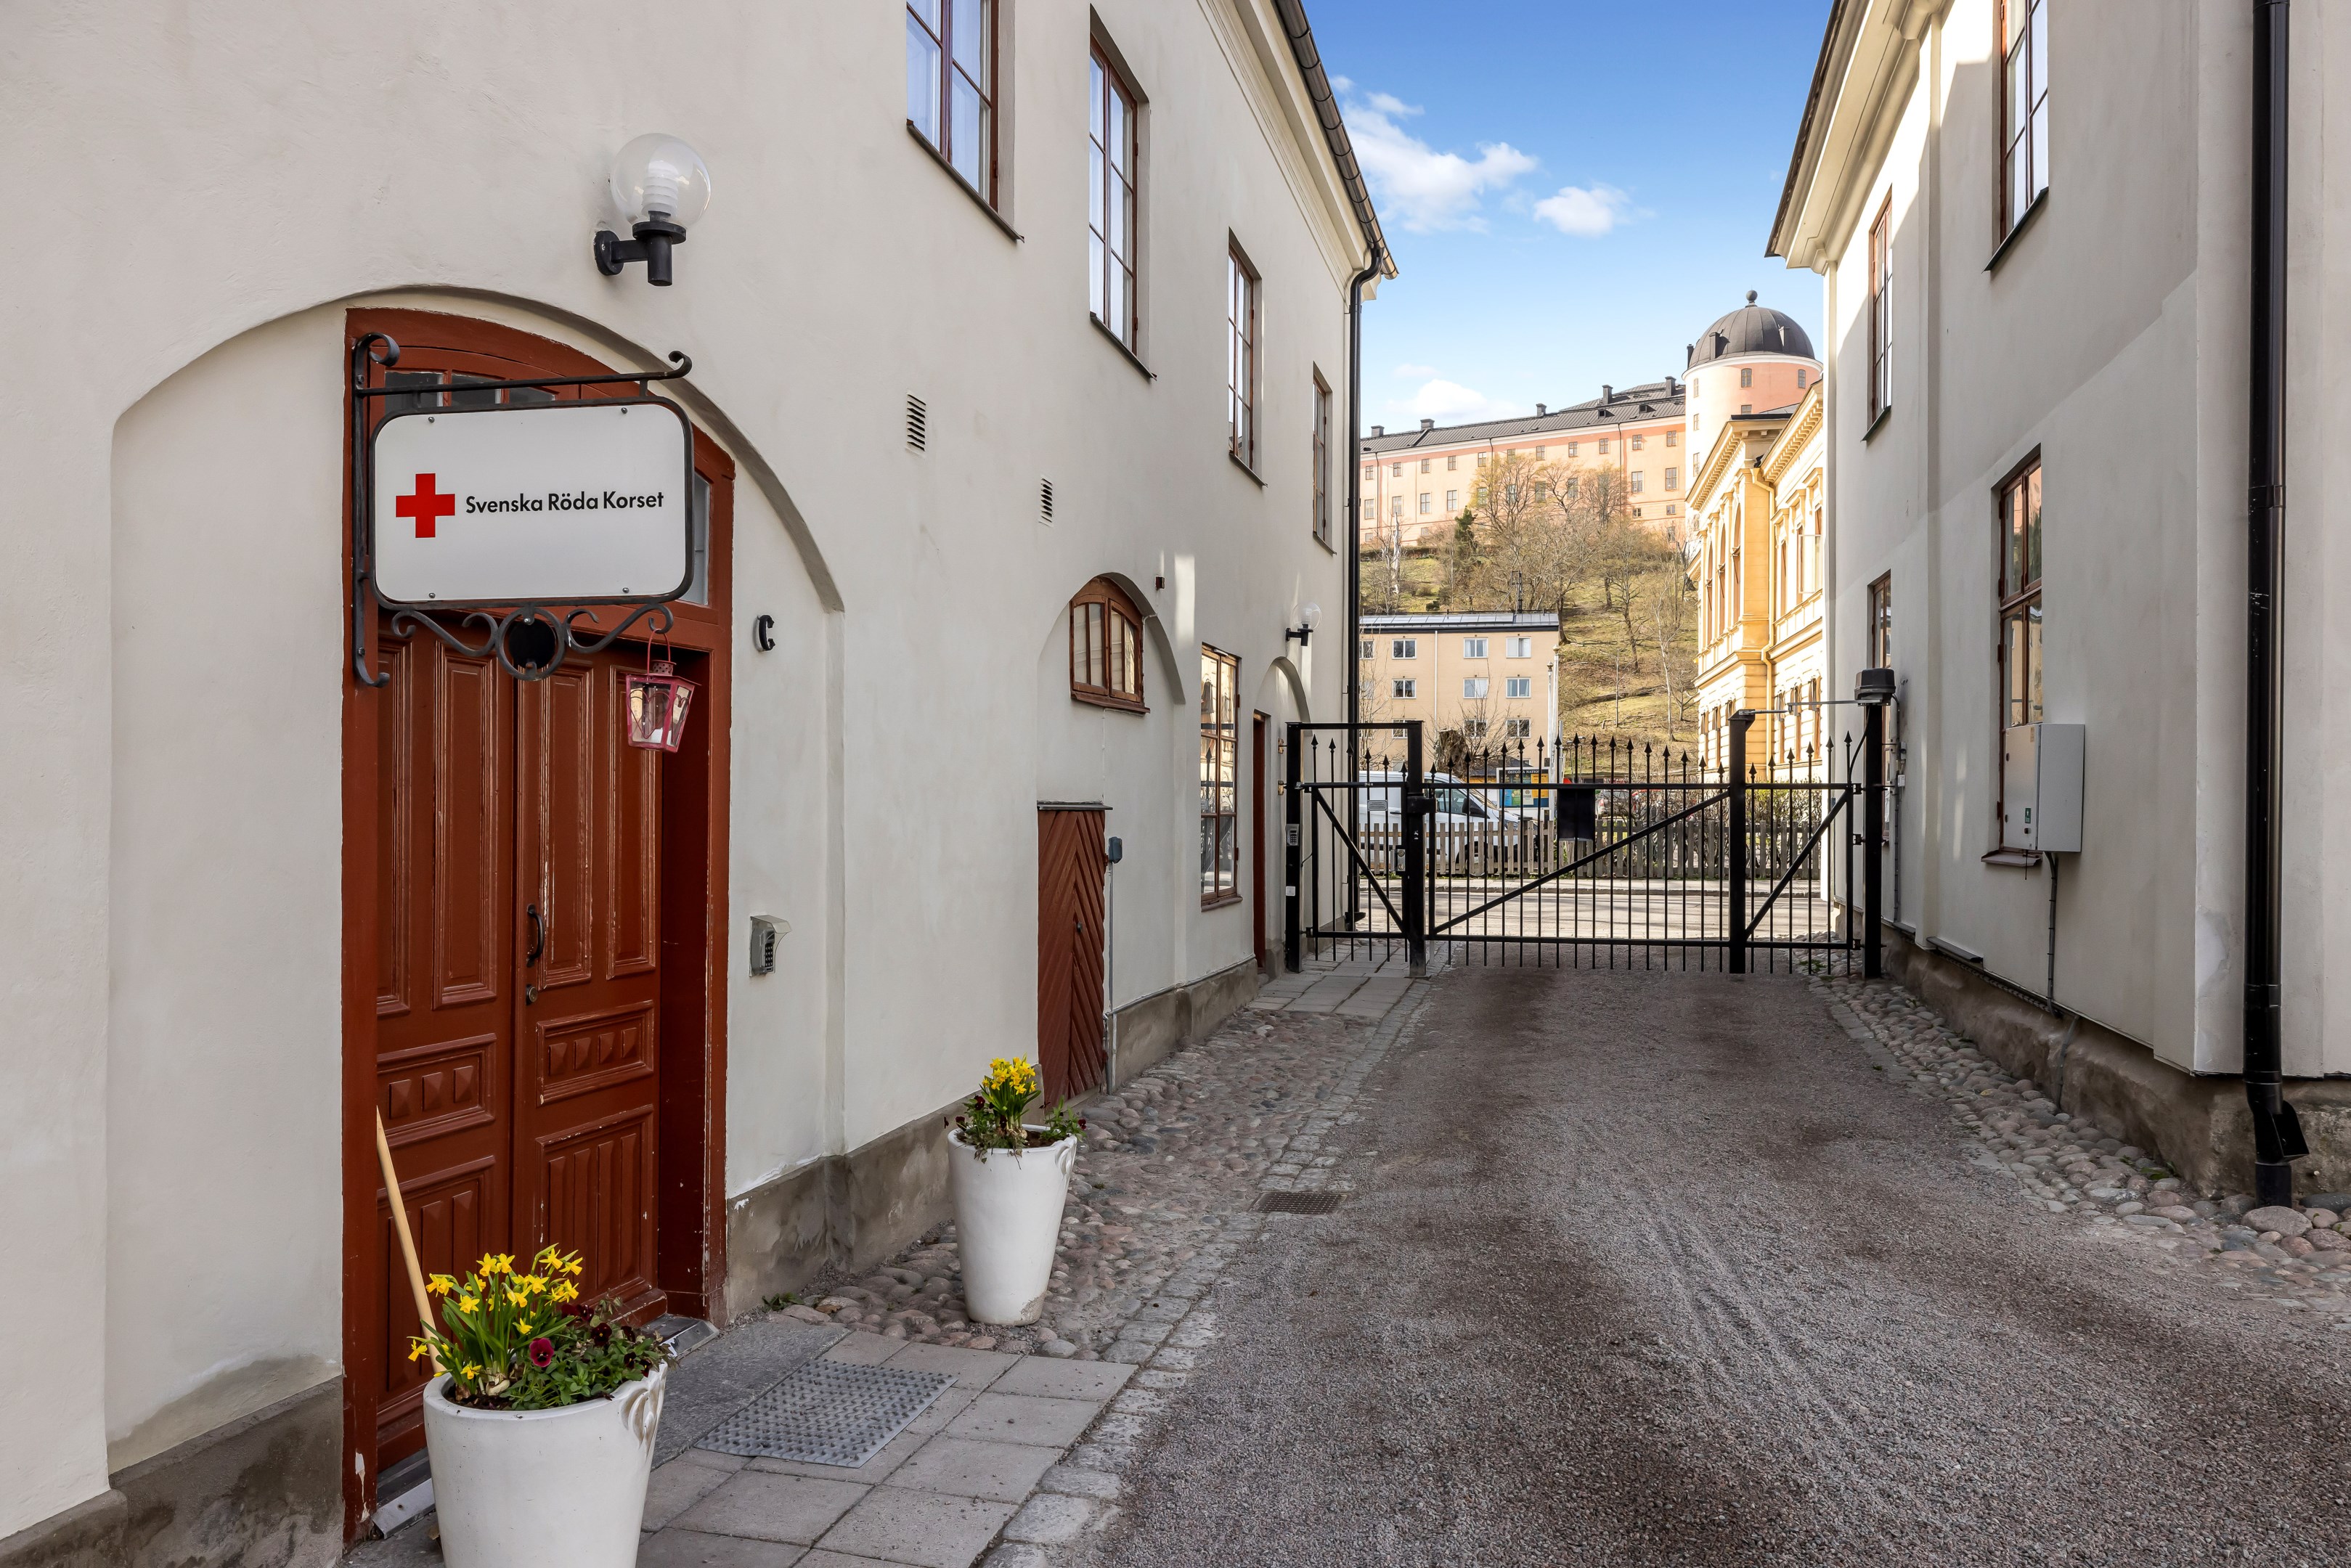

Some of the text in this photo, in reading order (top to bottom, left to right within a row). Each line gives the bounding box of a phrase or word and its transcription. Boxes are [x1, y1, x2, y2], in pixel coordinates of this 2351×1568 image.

[465, 491, 664, 514] Svenska Röda Korset
